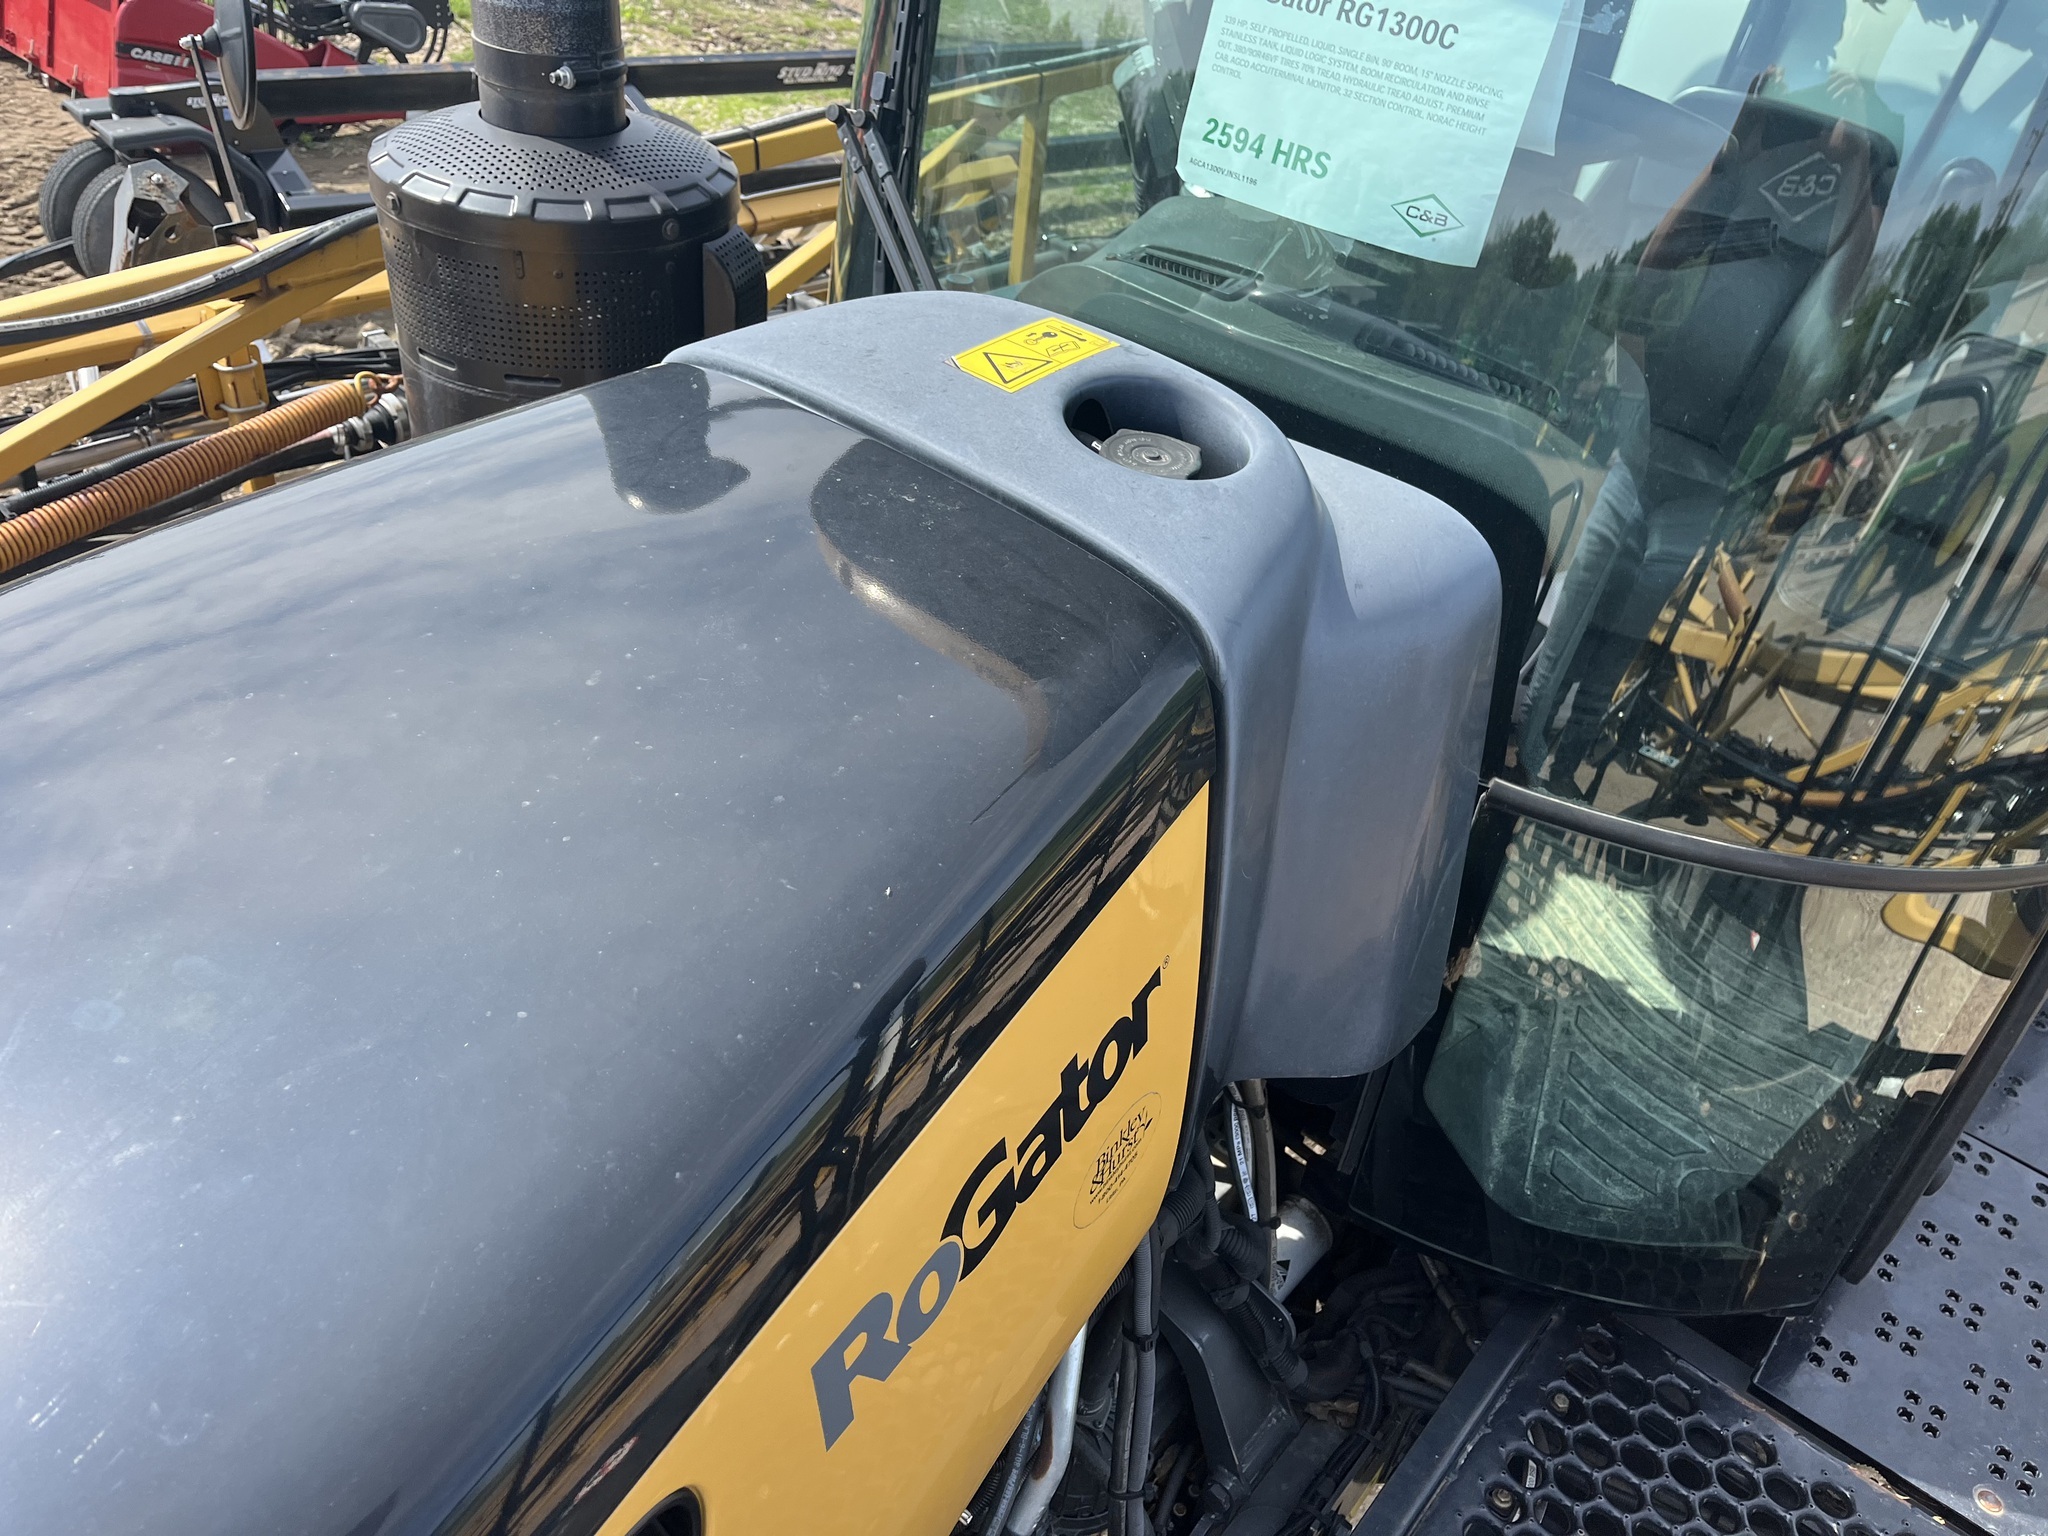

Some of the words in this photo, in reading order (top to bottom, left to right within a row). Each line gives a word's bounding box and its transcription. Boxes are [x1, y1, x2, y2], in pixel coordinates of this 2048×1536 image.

[1336, 0, 1459, 50] RG1300C
[1211, 63, 1242, 80] CONTROL
[1220, 27, 1257, 44] STAINLESS
[1280, 44, 1304, 57] LIQUID
[1305, 51, 1328, 63] LOGIC
[1327, 57, 1359, 73] SYSTEM,
[1360, 66, 1384, 79] BOOM
[1384, 72, 1446, 97] RECIRCULATION
[1446, 90, 1465, 102] AND
[1466, 95, 1491, 109] RINSE
[1224, 15, 1236, 25] 339
[1250, 22, 1267, 33] SELF
[1268, 27, 1310, 47] PROPELLED,
[1311, 39, 1336, 53] LIQUID,
[1339, 46, 1365, 61] SINGLE
[1394, 61, 1418, 77] BOOM,
[1434, 73, 1466, 89] NOZZLE
[1467, 81, 1504, 100] SPACING,
[1280, 56, 1300, 70] TIRES
[1301, 62, 1316, 74] 70%
[1342, 75, 1386, 94] HYDRAULIC
[1387, 87, 1412, 101] TREAD
[1446, 104, 1485, 121] PREMIUM
[1230, 56, 1250, 69] AGCO
[1250, 61, 1305, 85] ACCUTERMINAL
[1343, 87, 1353, 98] 32
[1354, 91, 1387, 108] SECTION
[1387, 101, 1425, 120] CONTROL,
[1426, 112, 1456, 127] NORAC
[1455, 120, 1487, 136] HEIGHT
[1202, 117, 1266, 159] 2594
[1271, 138, 1332, 179] HRS
[1406, 205, 1448, 227] C&B
